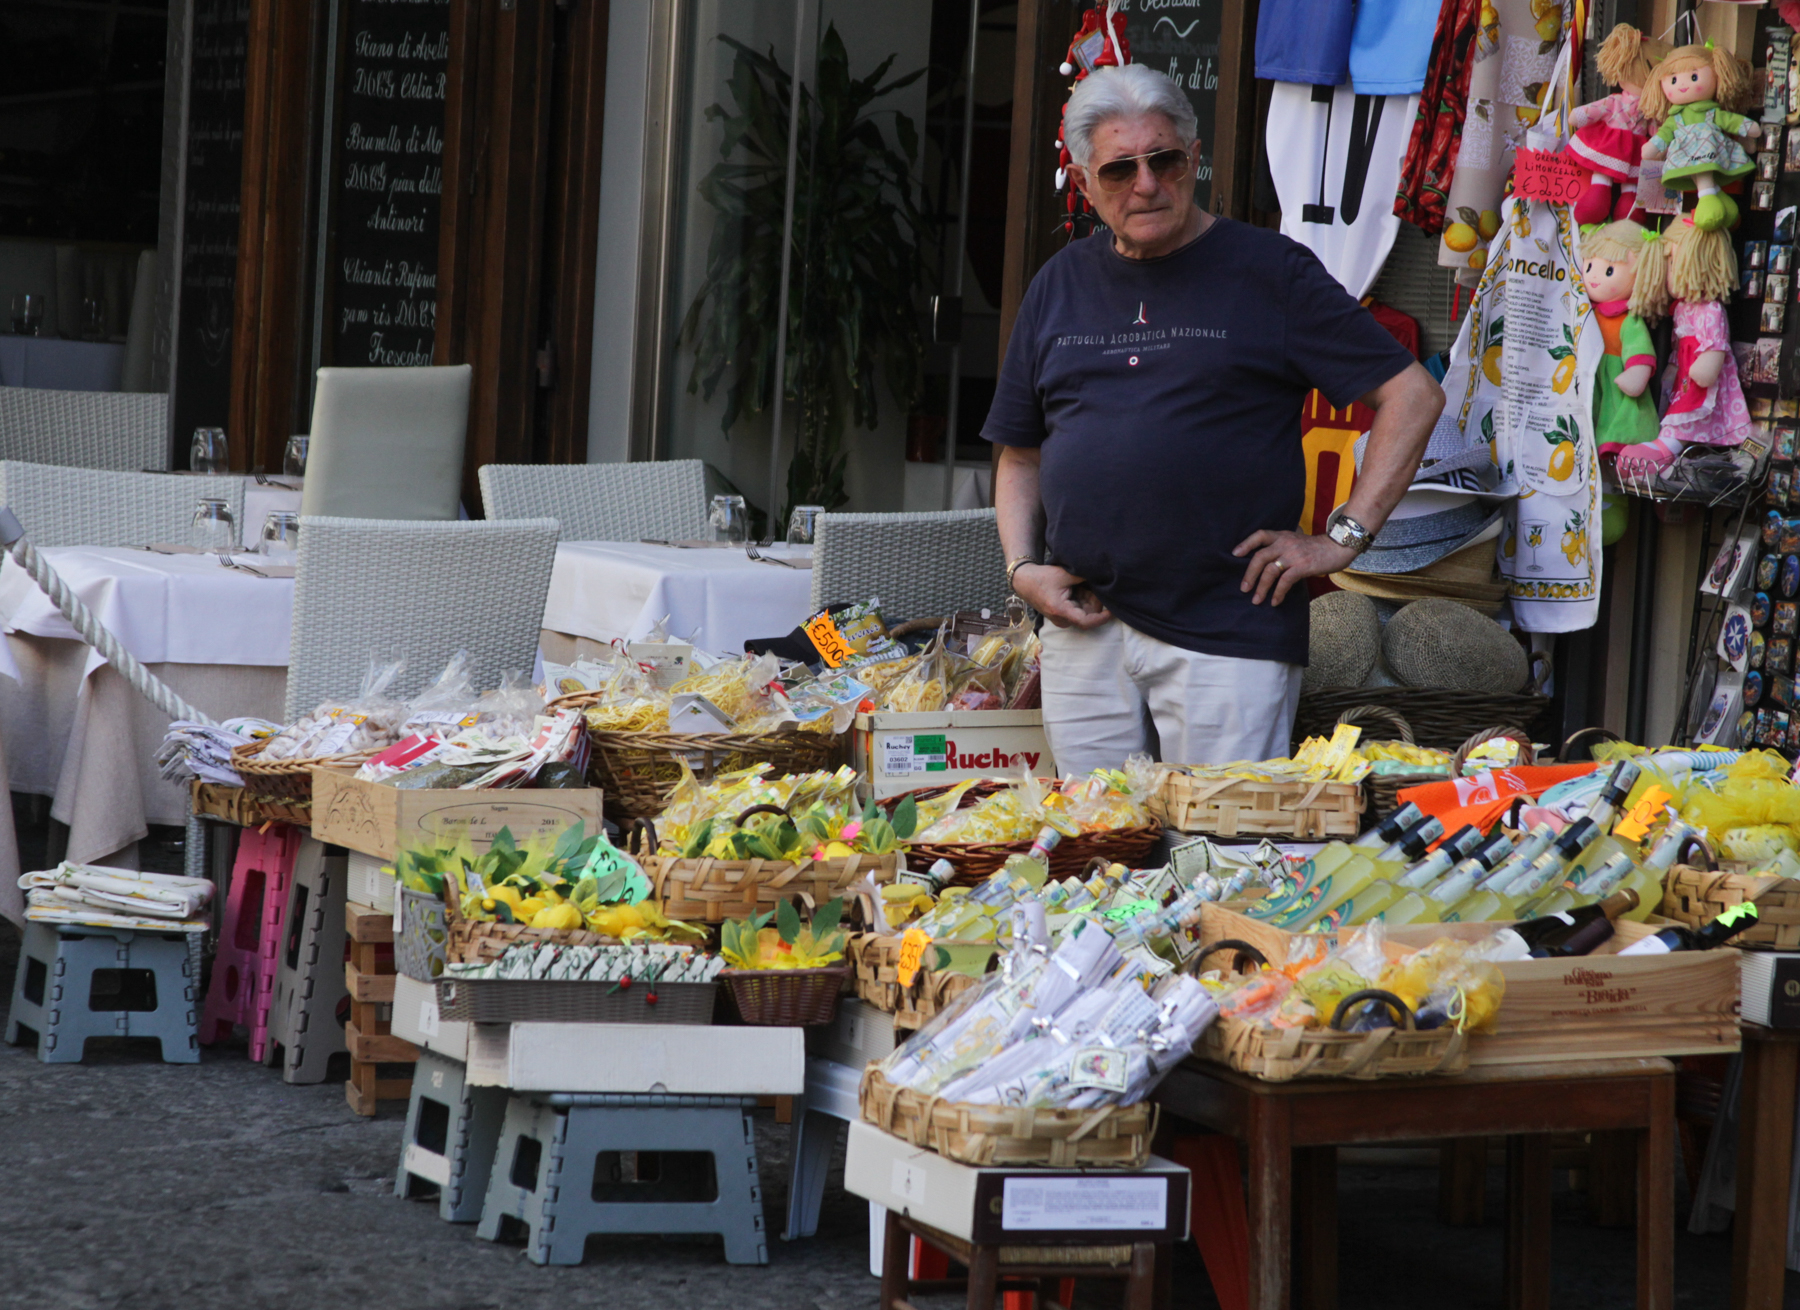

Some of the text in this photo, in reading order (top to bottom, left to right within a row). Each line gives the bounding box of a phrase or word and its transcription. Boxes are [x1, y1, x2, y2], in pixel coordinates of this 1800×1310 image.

[355, 31, 394, 58] Fiano
[397, 31, 411, 59] di
[345, 122, 401, 153] Brunello
[405, 125, 419, 153] di
[367, 203, 427, 233] Antinori
[343, 257, 392, 286] Chianti
[1057, 326, 1228, 347] PATTUGLIA ACROBATICA NAZIONALE
